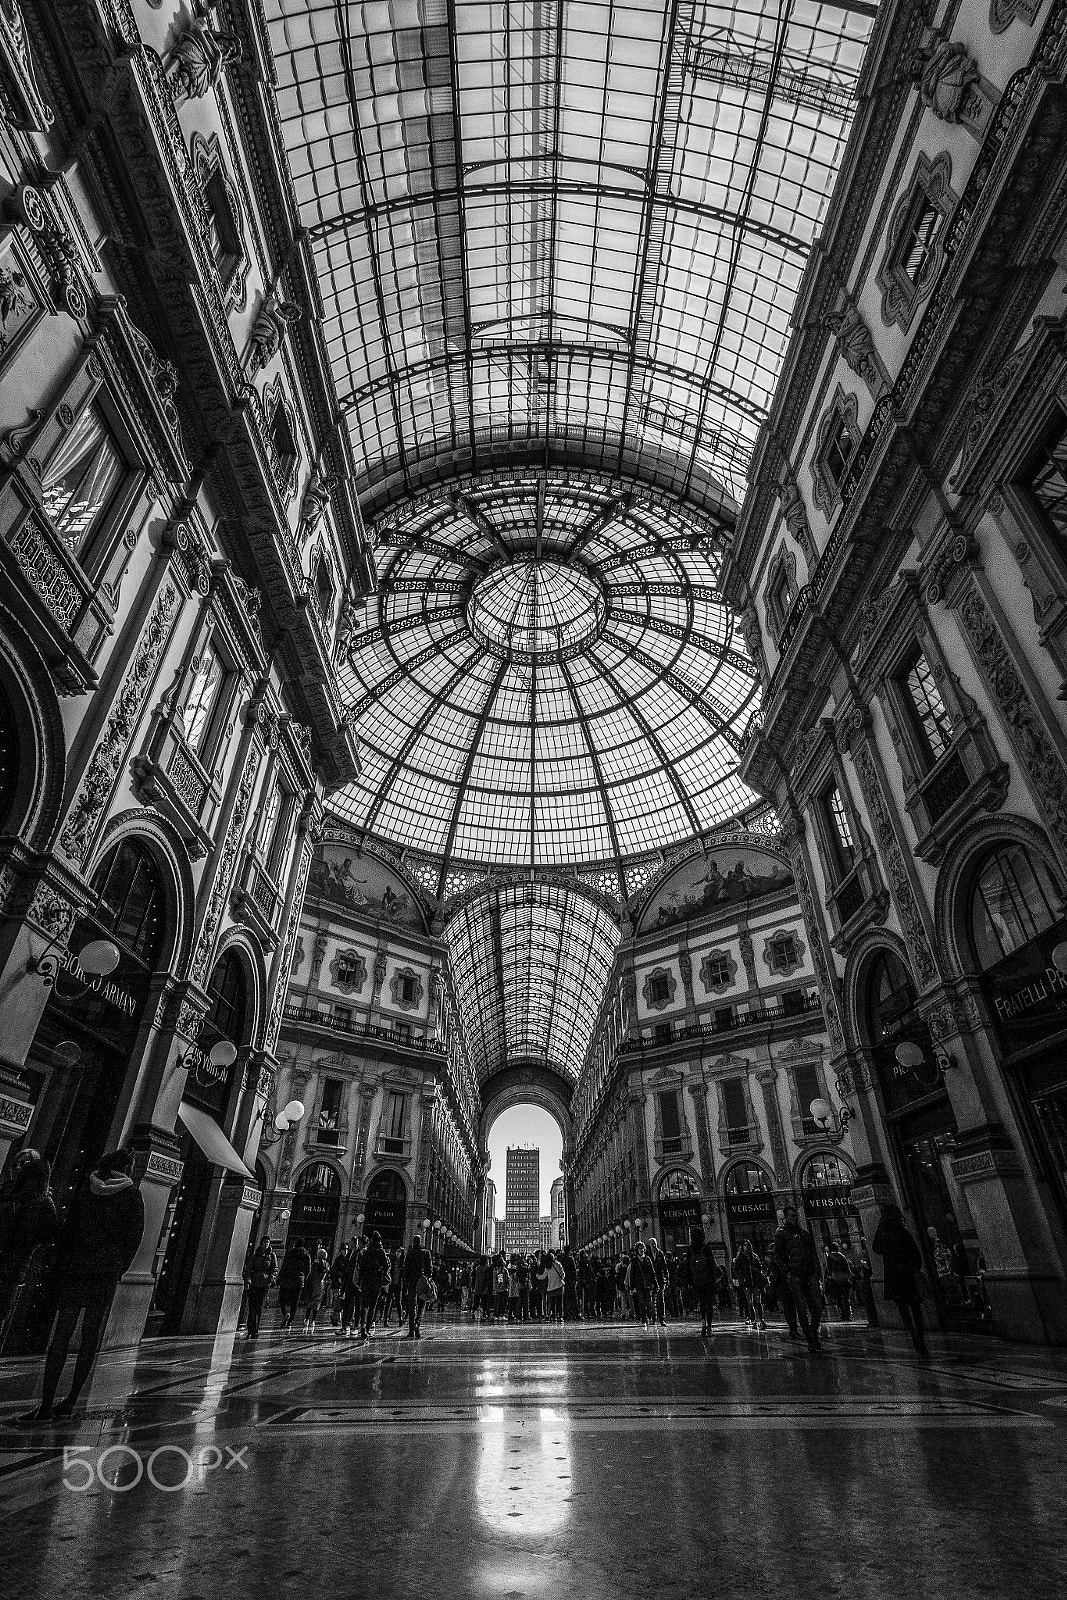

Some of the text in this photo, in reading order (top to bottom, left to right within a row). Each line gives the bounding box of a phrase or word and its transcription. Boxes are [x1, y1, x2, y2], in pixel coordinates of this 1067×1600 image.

[101, 980, 137, 1017] ARMANI
[994, 979, 1048, 1022] FRATELLI
[809, 1196, 853, 1208] VERSACE
[303, 1205, 326, 1213] PRADA
[663, 1208, 697, 1218] VERSACE
[731, 1203, 770, 1213] VERSACE
